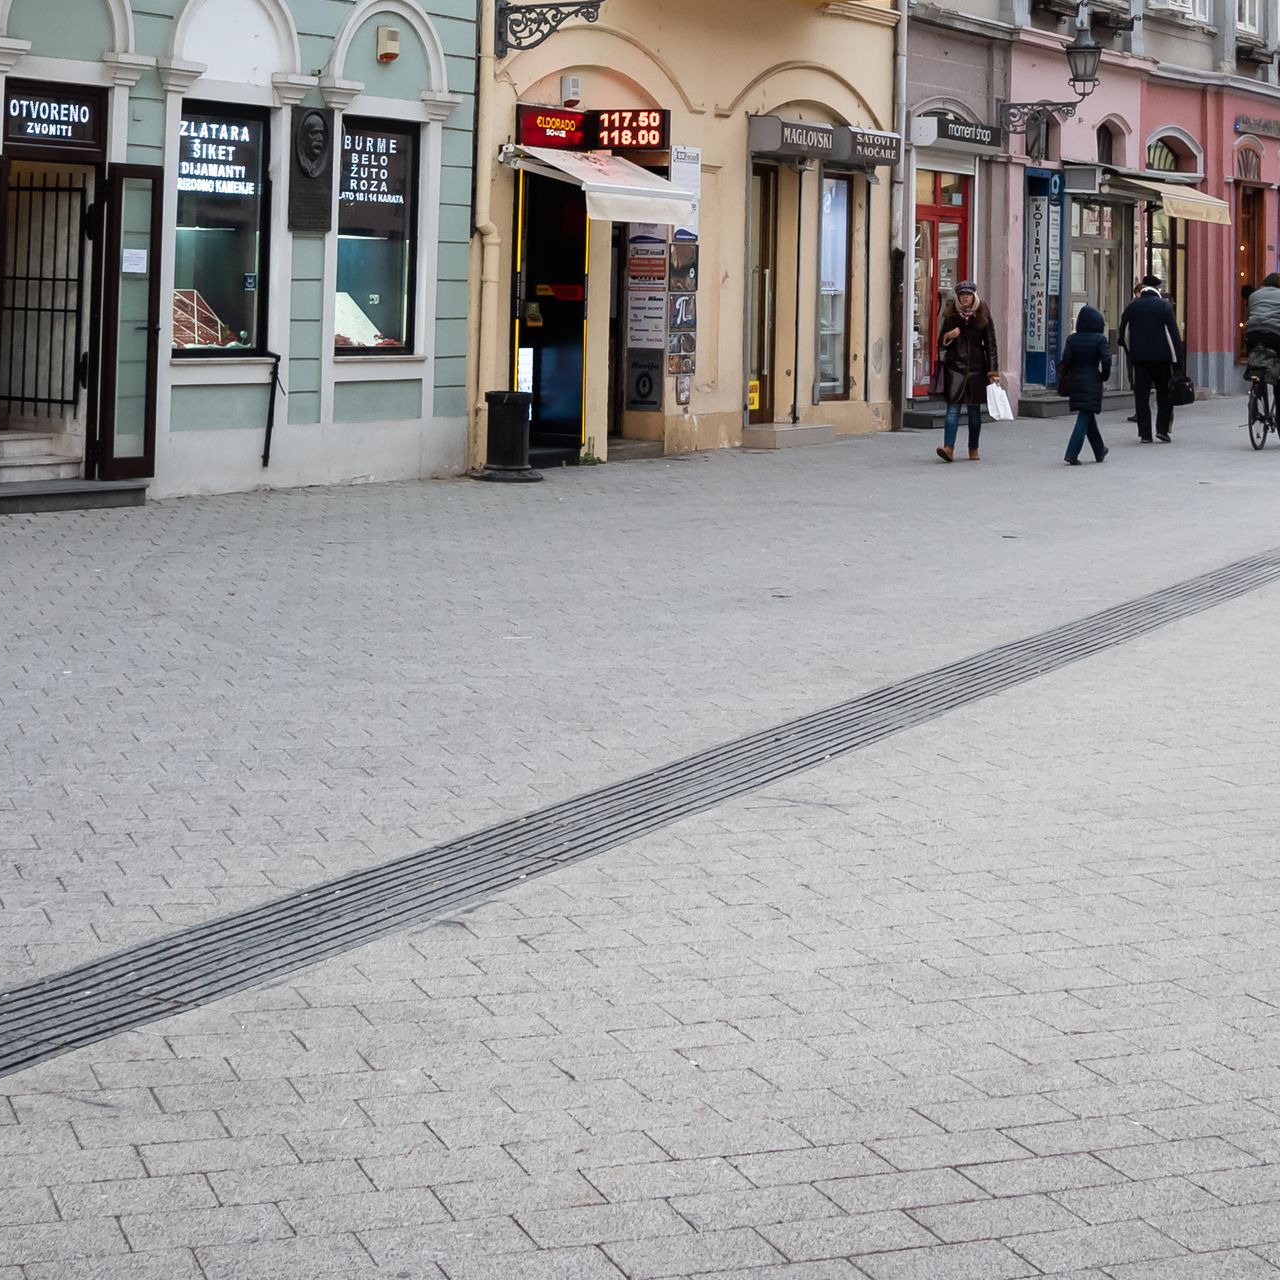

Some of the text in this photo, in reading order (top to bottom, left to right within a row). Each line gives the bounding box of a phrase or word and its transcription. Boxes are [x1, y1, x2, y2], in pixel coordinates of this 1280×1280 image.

[10, 99, 90, 123] OTVORENO
[600, 111, 660, 128] 117.50
[26, 122, 72, 137] ZVONITI
[179, 121, 250, 142] ZLATARA
[600, 129, 660, 145] 118.00
[783, 127, 833, 149] MAGLOVSKI
[948, 123, 991, 144] moment shop
[344, 135, 397, 153] BURME
[856, 133, 890, 146] SATOVI
[192, 139, 236, 161] ŠIKET
[856, 145, 896, 159] NAOČARE
[351, 153, 388, 166] BELO
[181, 161, 246, 178] DIJAMANTI
[350, 164, 388, 179] ŽUTO
[350, 179, 388, 192] ROZA
[356, 192, 364, 201] 18
[369, 193, 376, 202] 14
[378, 194, 404, 204] KARATA
[1032, 204, 1044, 280] KOPIRNICA
[1036, 291, 1044, 341] MARKET
